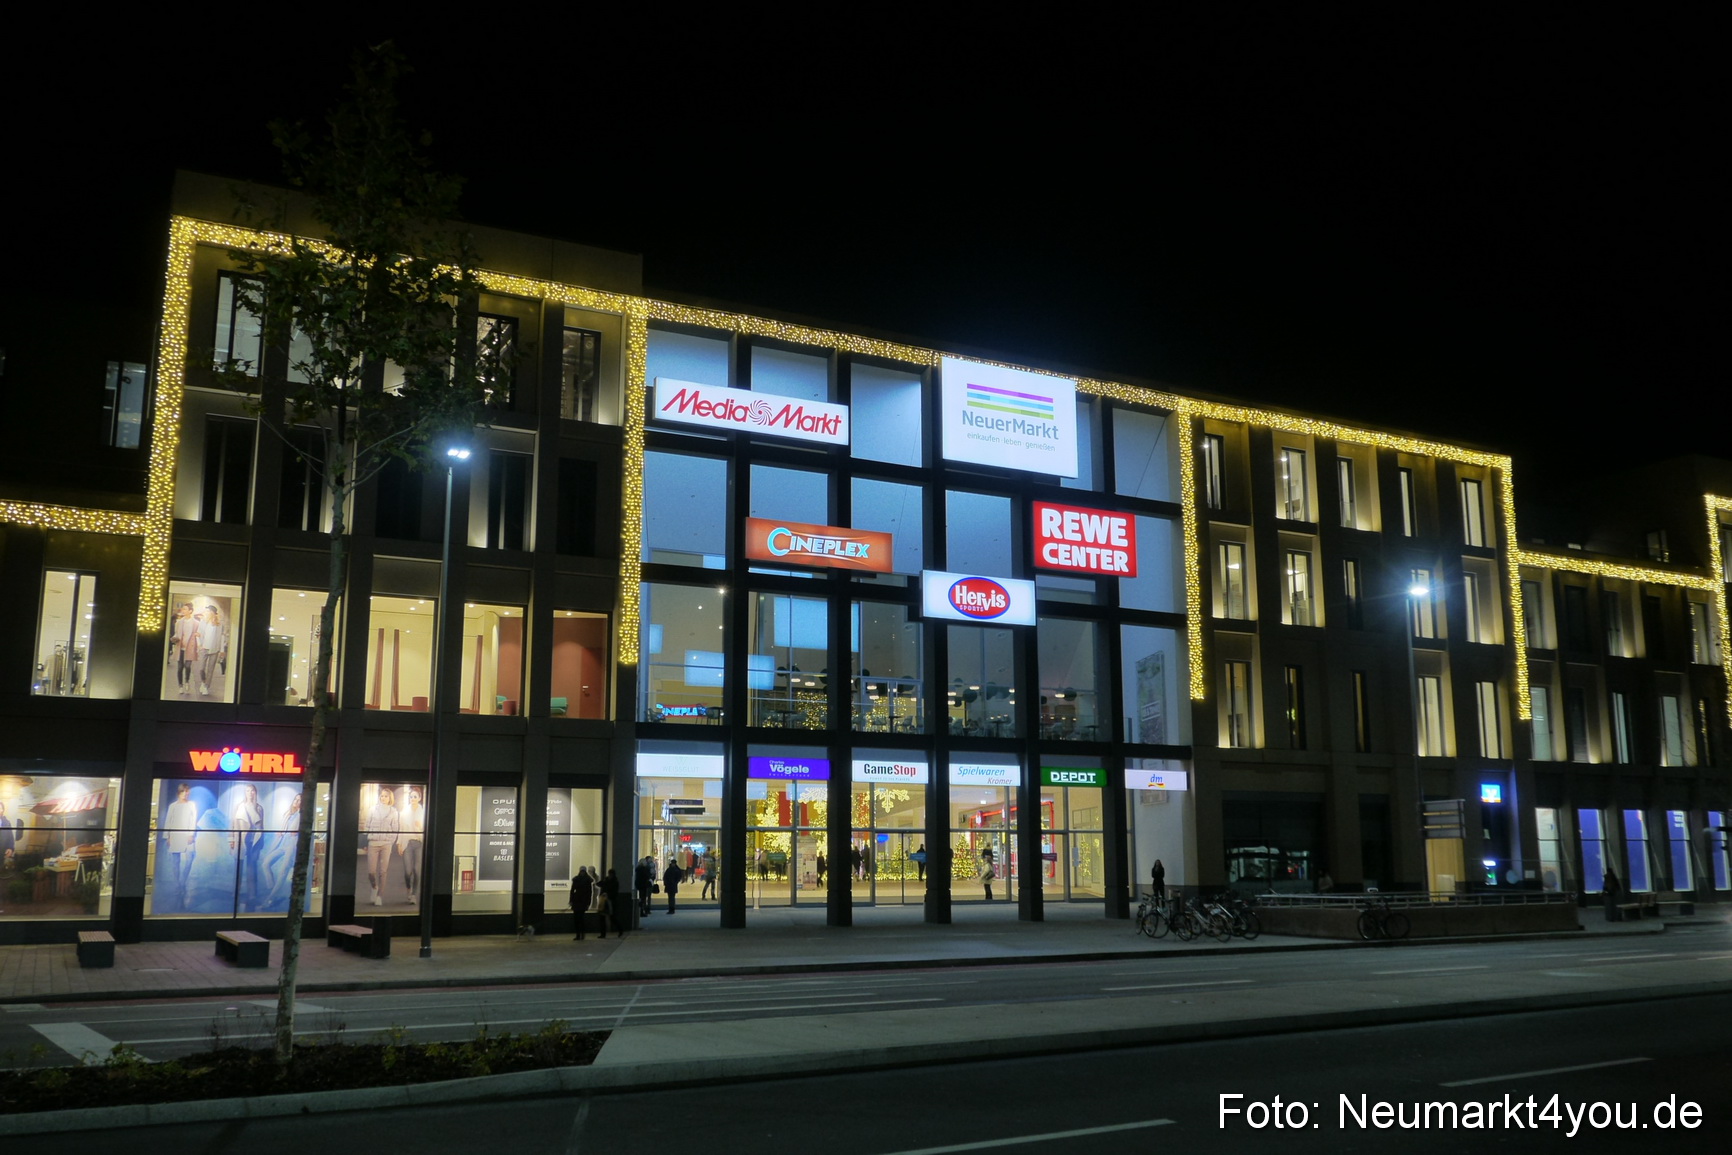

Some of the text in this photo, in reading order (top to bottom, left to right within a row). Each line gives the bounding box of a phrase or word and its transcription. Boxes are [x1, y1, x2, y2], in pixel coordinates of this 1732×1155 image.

[662, 388, 842, 436] Media Markt
[962, 410, 1059, 440] NeuerMarkt
[967, 432, 1056, 452] einkaufen leben genießen
[1041, 507, 1129, 547] REWE
[767, 527, 870, 558] CINEPLEX
[1042, 543, 1129, 573] CENTER
[955, 584, 1006, 612] Hervis
[189, 747, 302, 774] WÖHRL
[769, 764, 810, 775] Vögele
[864, 763, 916, 777] GameStop
[957, 766, 1006, 777] Spielwaren
[1050, 771, 1096, 783] DEPOT
[1149, 773, 1163, 783] dm
